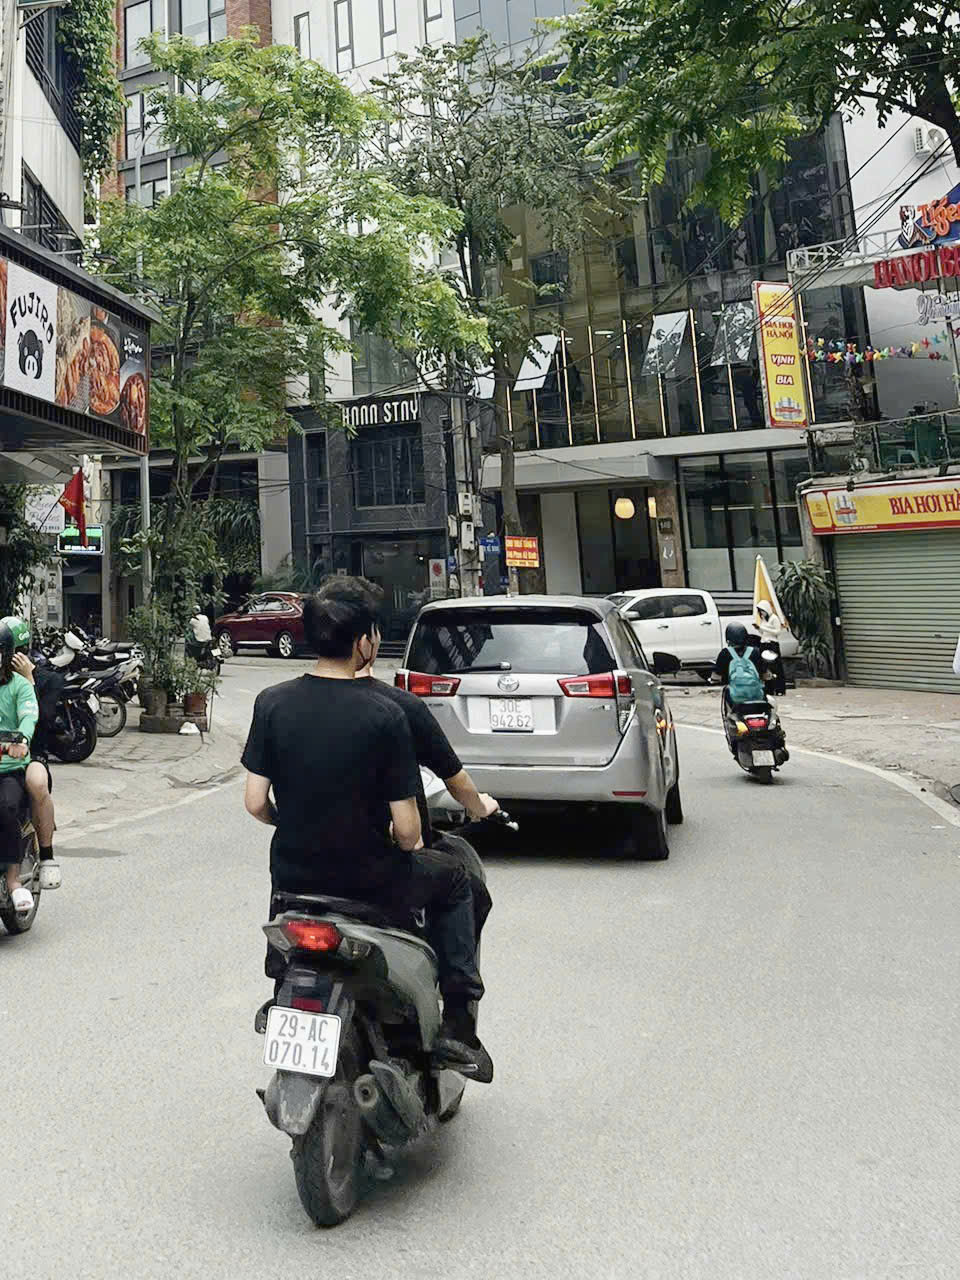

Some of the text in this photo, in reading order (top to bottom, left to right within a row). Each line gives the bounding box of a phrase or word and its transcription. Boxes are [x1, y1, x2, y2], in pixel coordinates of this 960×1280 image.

[873, 250, 938, 289] HANOI
[9, 292, 53, 344] FUJIRO
[776, 375, 794, 385] BIA
[889, 496, 914, 515] BIA
[278, 1014, 328, 1043] 29-AC
[268, 1040, 330, 1071] 070.14
